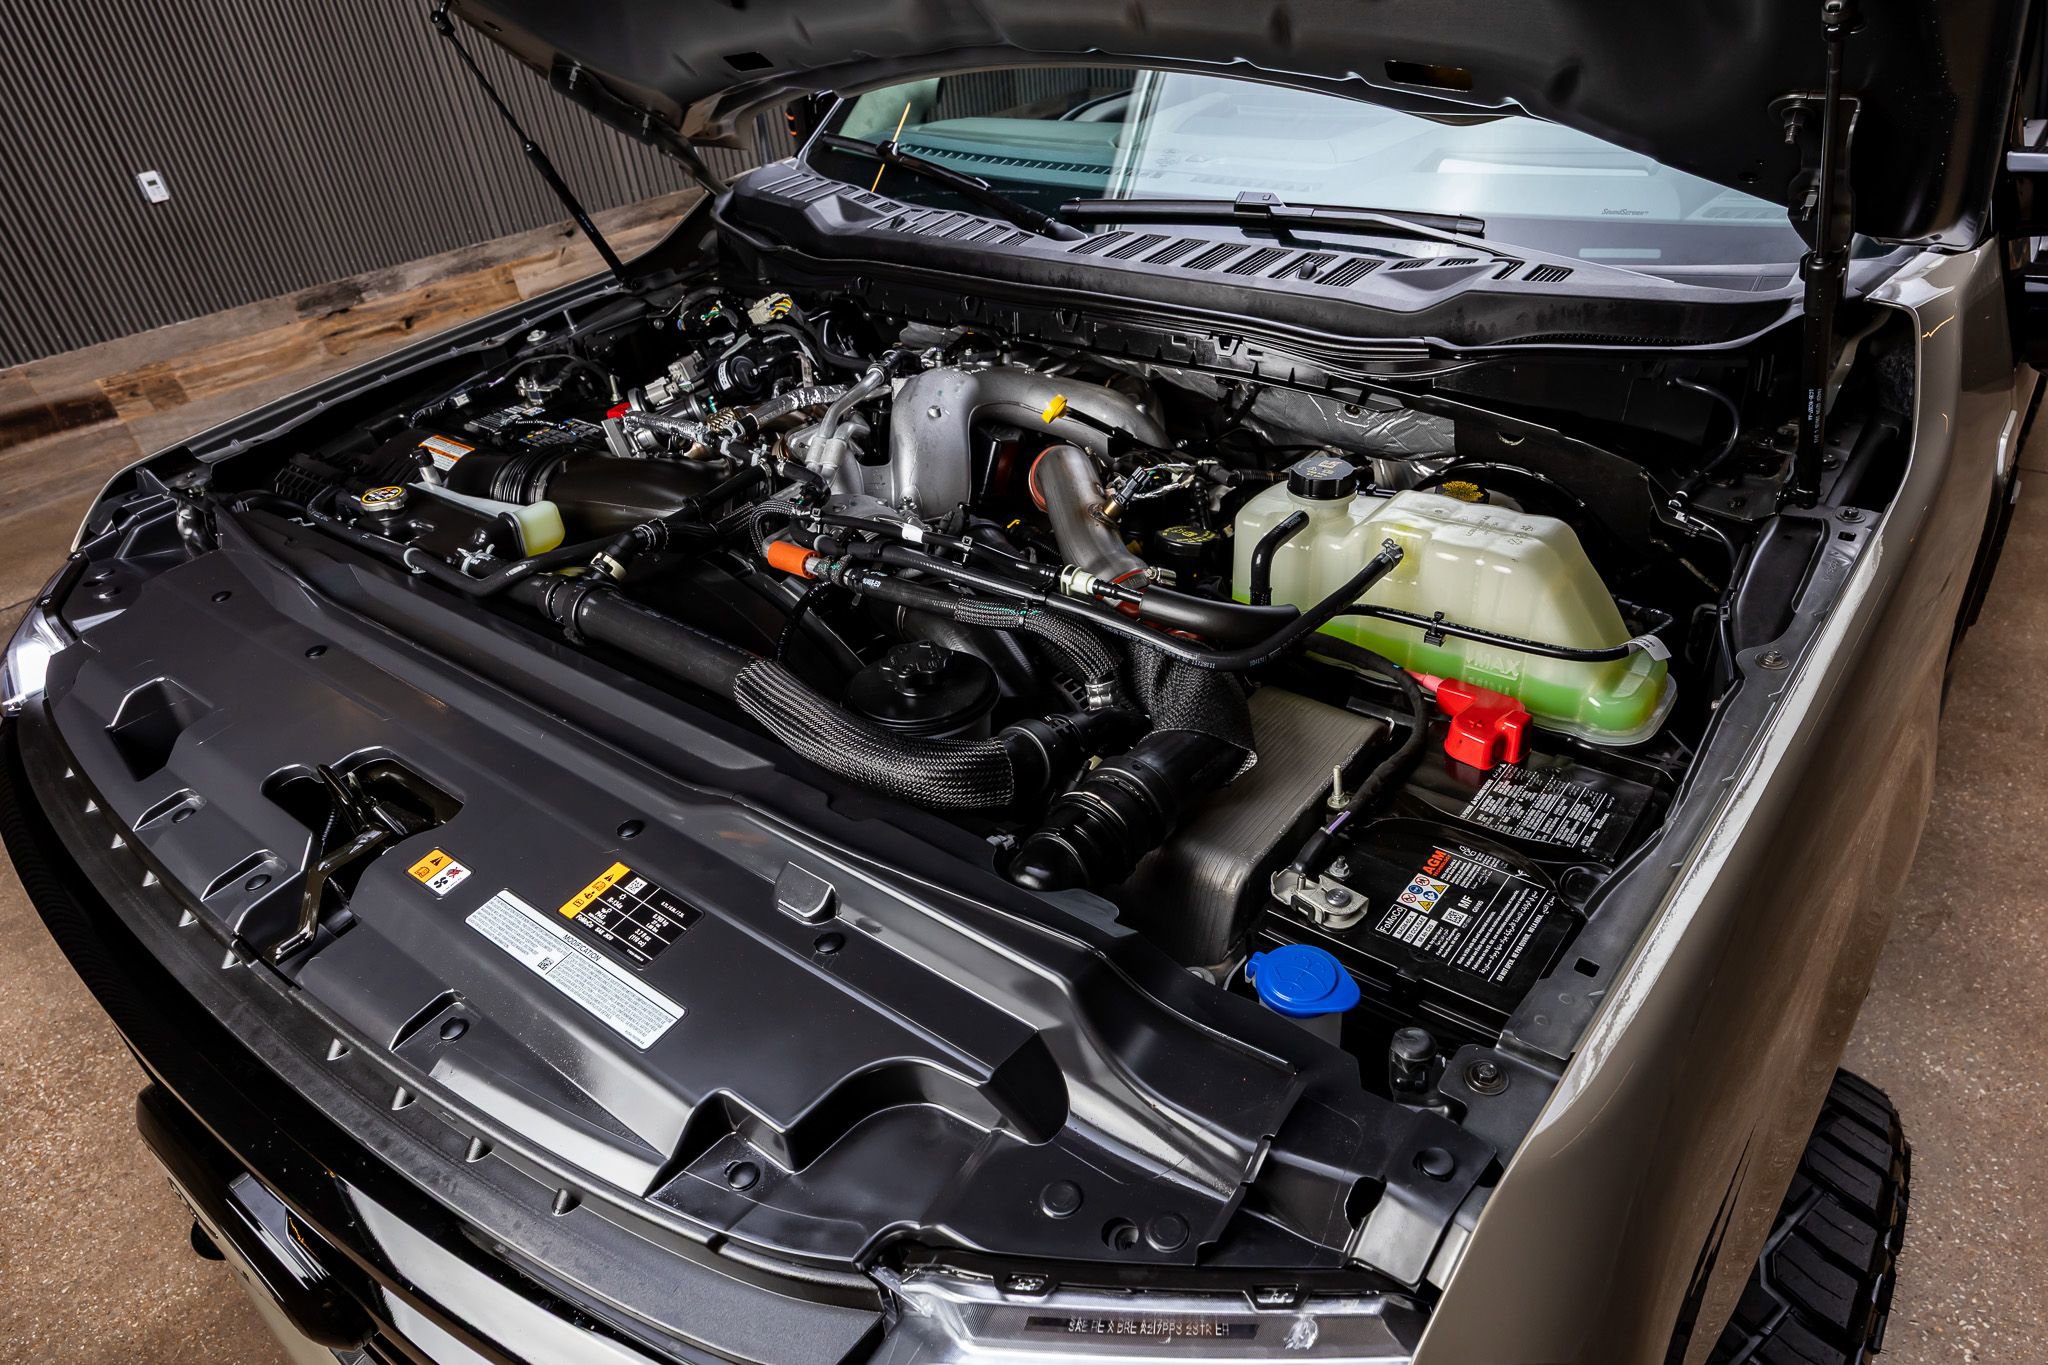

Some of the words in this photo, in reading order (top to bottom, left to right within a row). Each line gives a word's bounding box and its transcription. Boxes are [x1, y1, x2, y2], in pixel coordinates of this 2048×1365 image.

[1421, 849, 1446, 874] AGM
[1457, 894, 1474, 909] MF
[1379, 905, 1403, 933] FoMoCo
[562, 933, 601, 962] MODIFICATION
[1069, 1318, 1087, 1332] SAE
